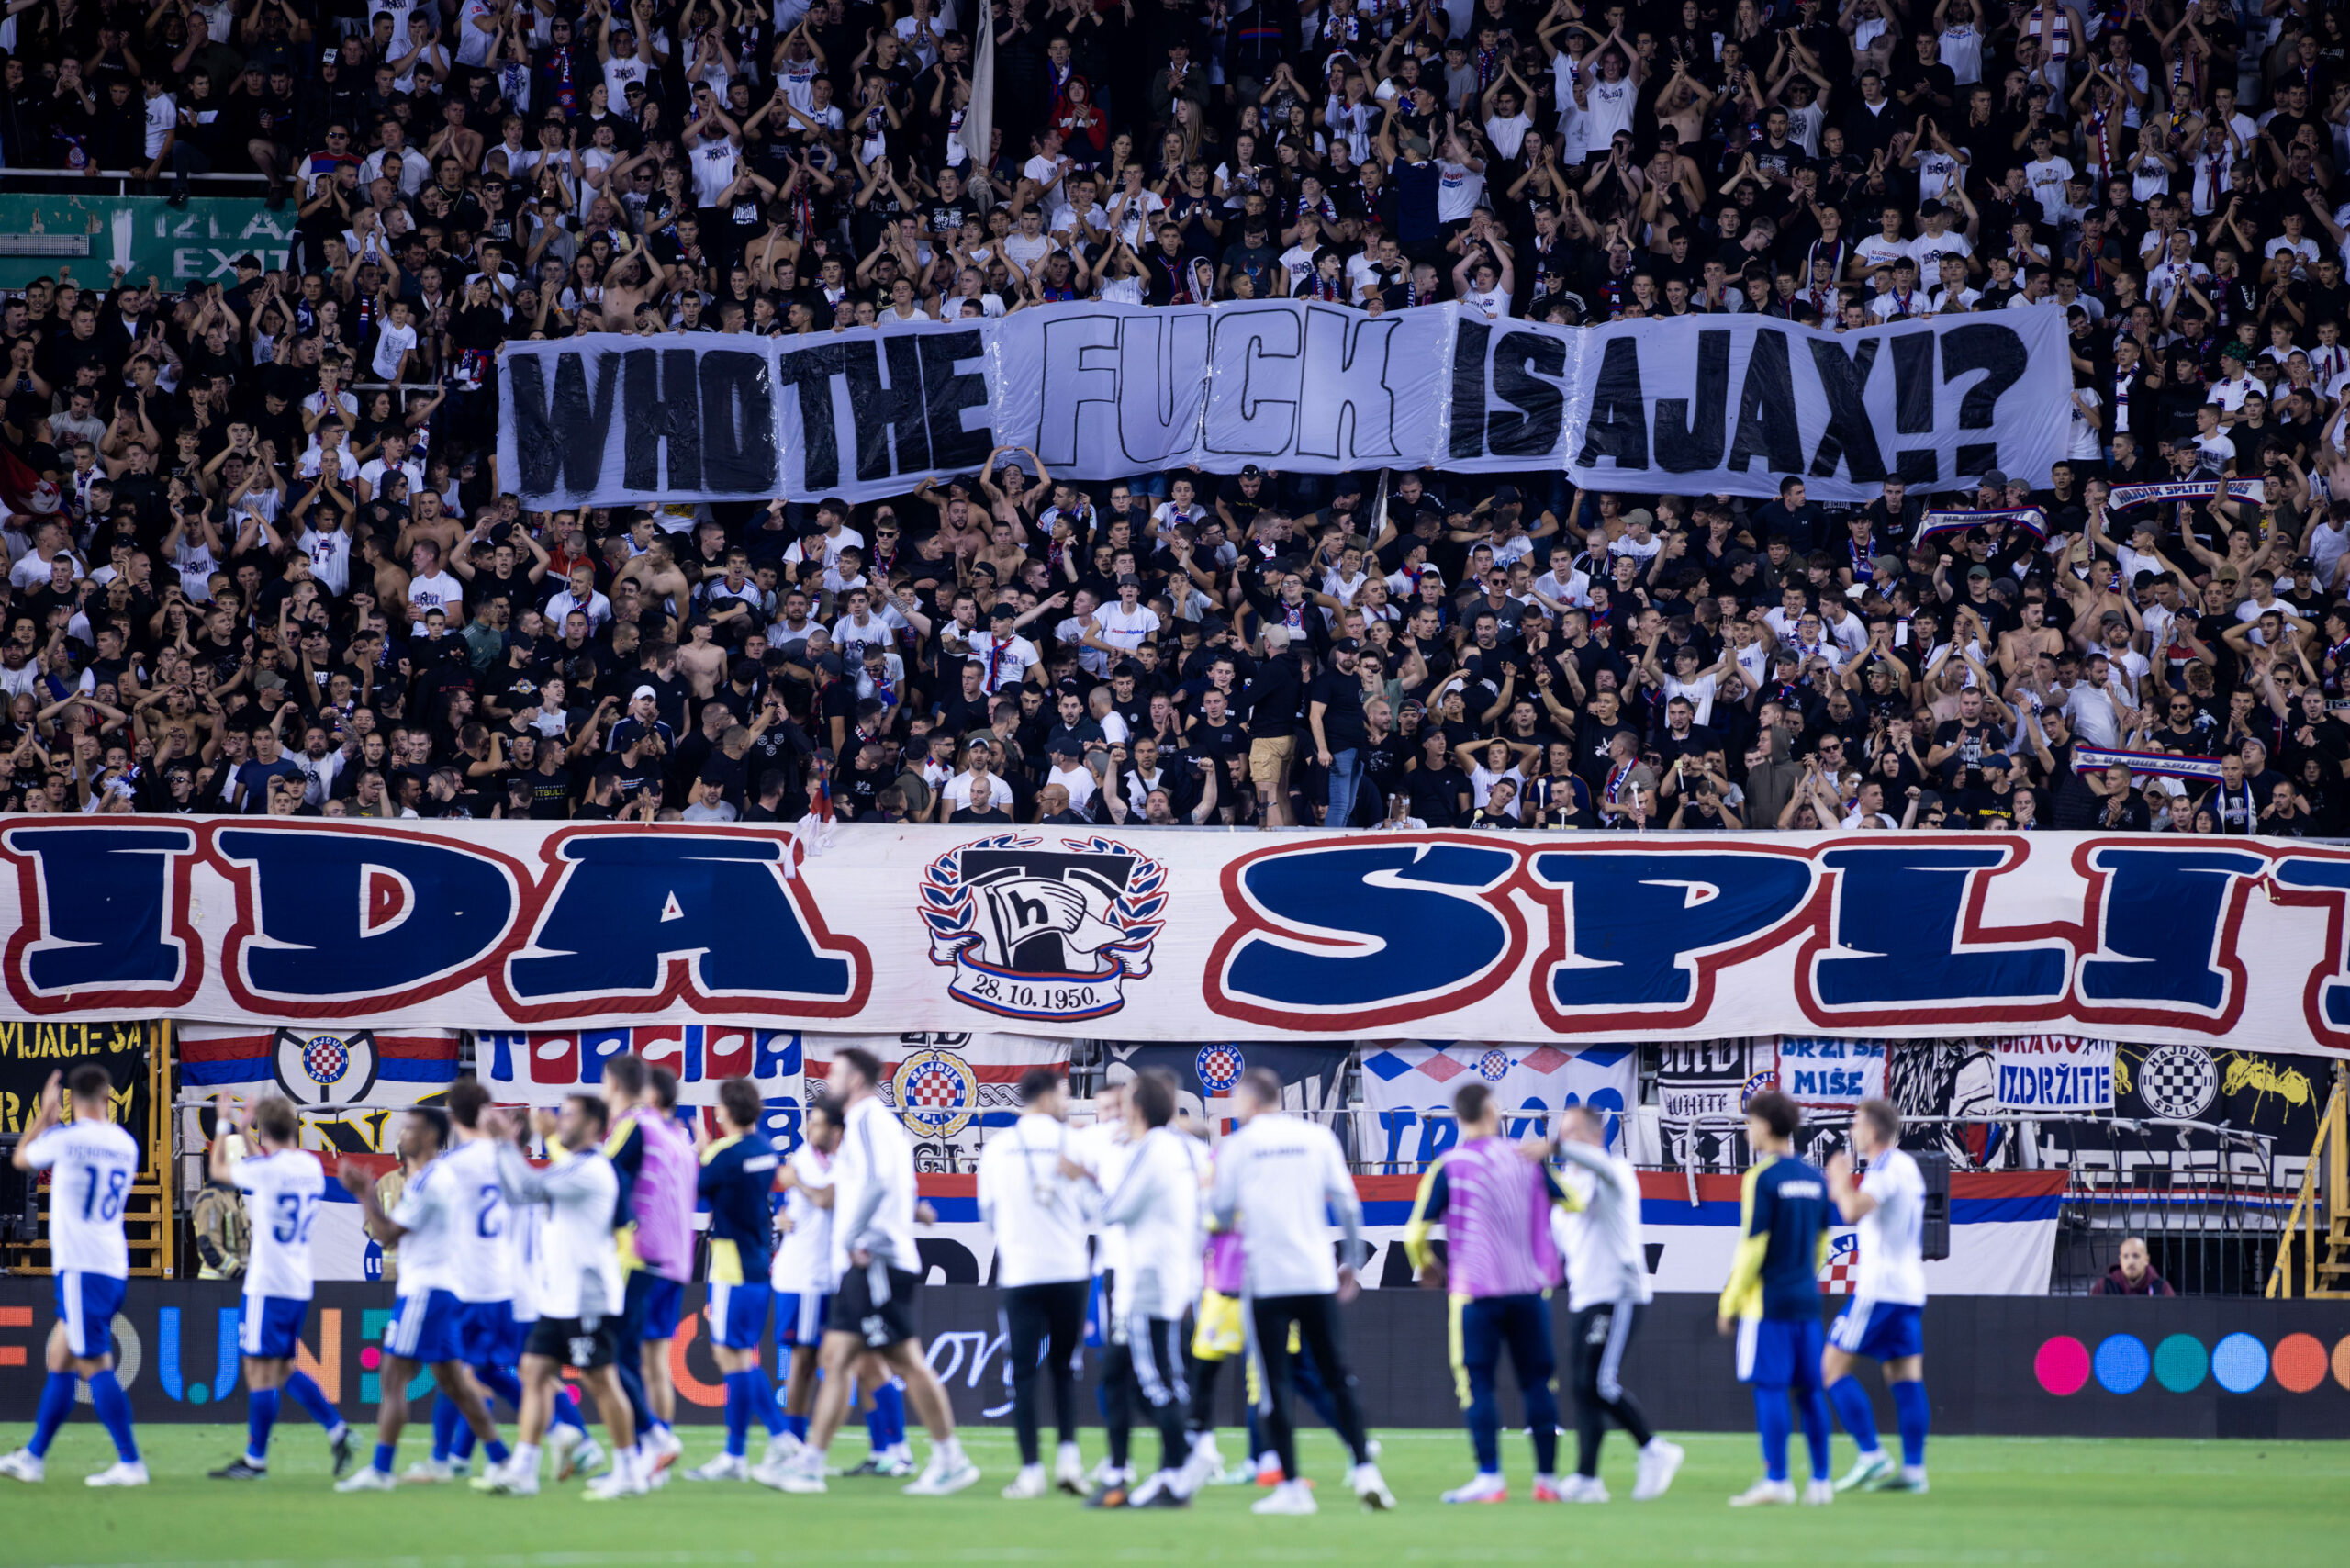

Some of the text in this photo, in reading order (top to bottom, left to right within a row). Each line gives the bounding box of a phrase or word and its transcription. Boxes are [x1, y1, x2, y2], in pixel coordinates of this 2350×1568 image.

[509, 307, 2028, 495] WHO THE FUCK IS AJAX!?
[2115, 486, 2163, 504] HAJDUK
[2165, 484, 2200, 495] SPLIT
[307, 1036, 346, 1053] HAJDUK
[1201, 1043, 1238, 1060] HAJDUK
[2148, 1044, 2210, 1069] HAJDUK
[308, 1070, 341, 1082] SPLIT
[910, 1062, 962, 1086] HAJDUK
[1793, 1068, 1864, 1096] MIŠE
[1999, 1063, 2109, 1104] IZDRŽITE
[2153, 1098, 2201, 1117] SPLIT
[81, 1164, 129, 1224] 18
